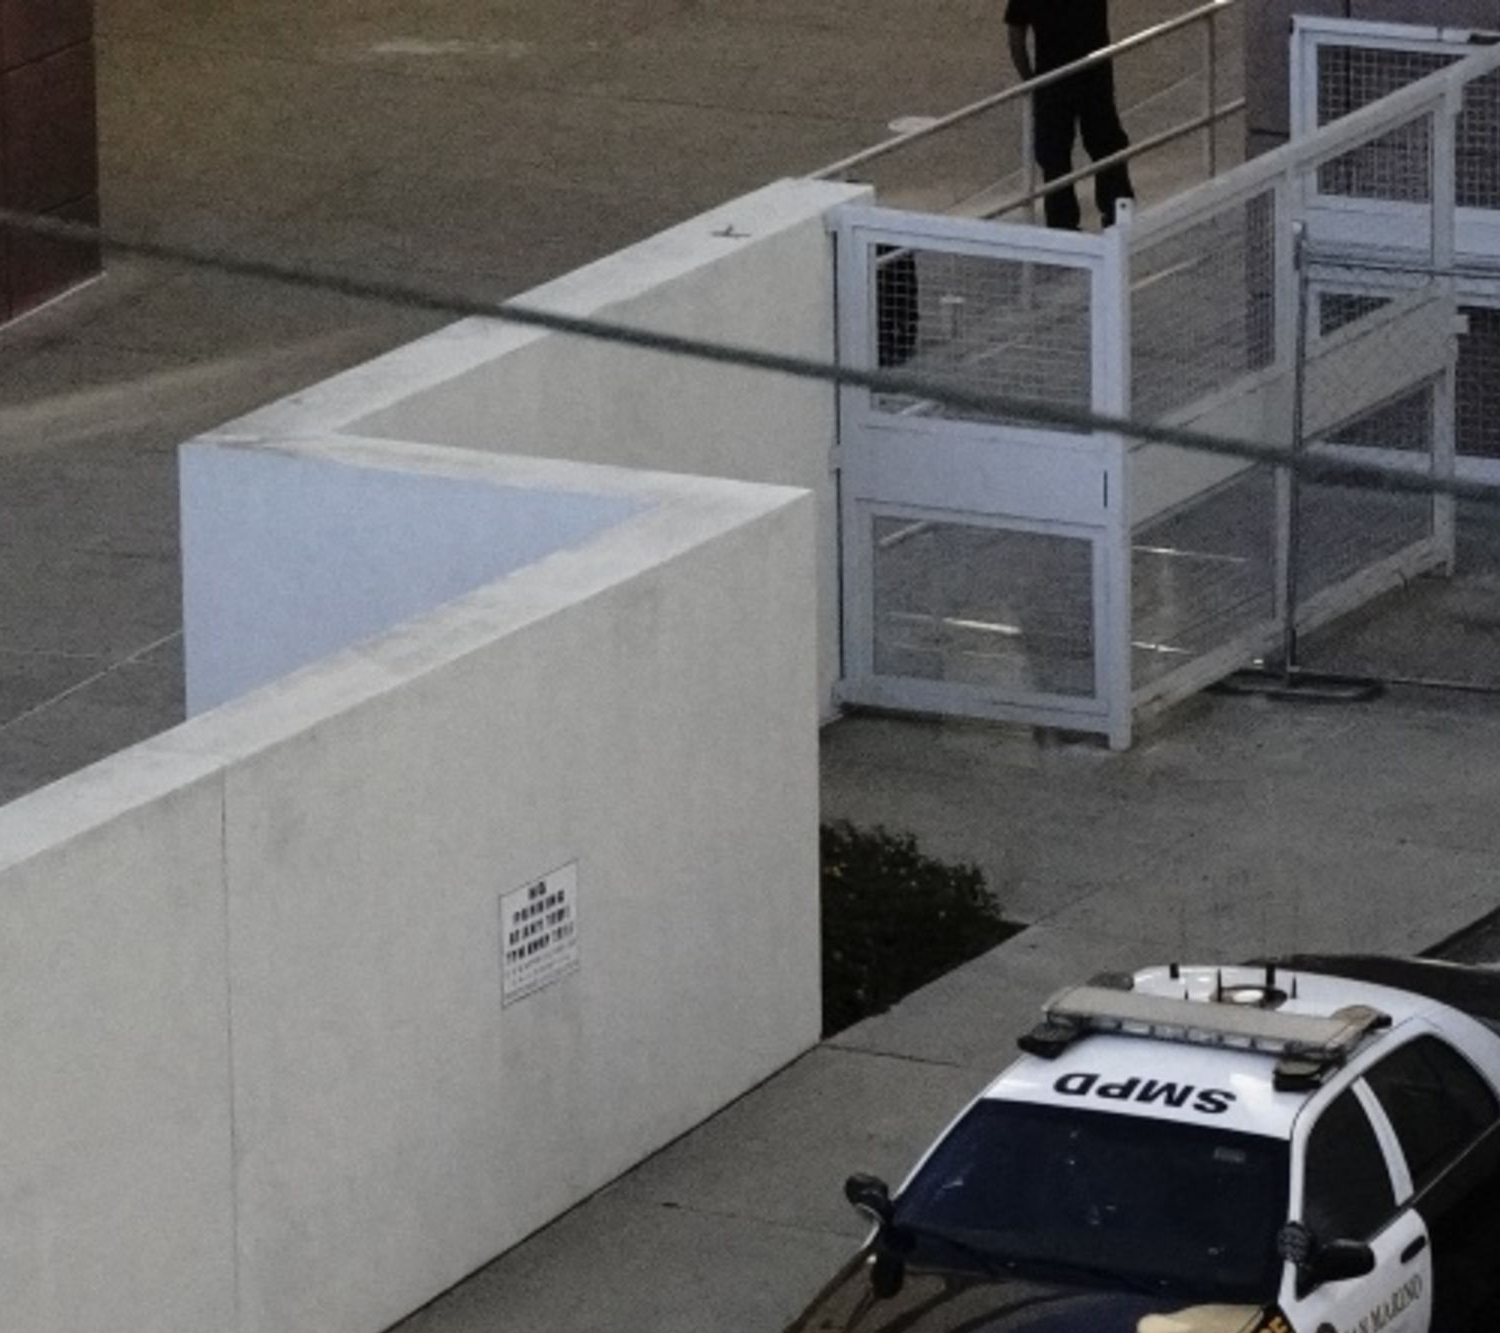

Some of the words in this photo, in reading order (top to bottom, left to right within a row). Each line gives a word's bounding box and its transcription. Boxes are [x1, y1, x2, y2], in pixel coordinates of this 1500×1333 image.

[513, 890, 565, 925] PARKING
[528, 880, 546, 900] NO
[1053, 1072, 1237, 1114] SMPD
[1369, 1273, 1424, 1332] MARINO
